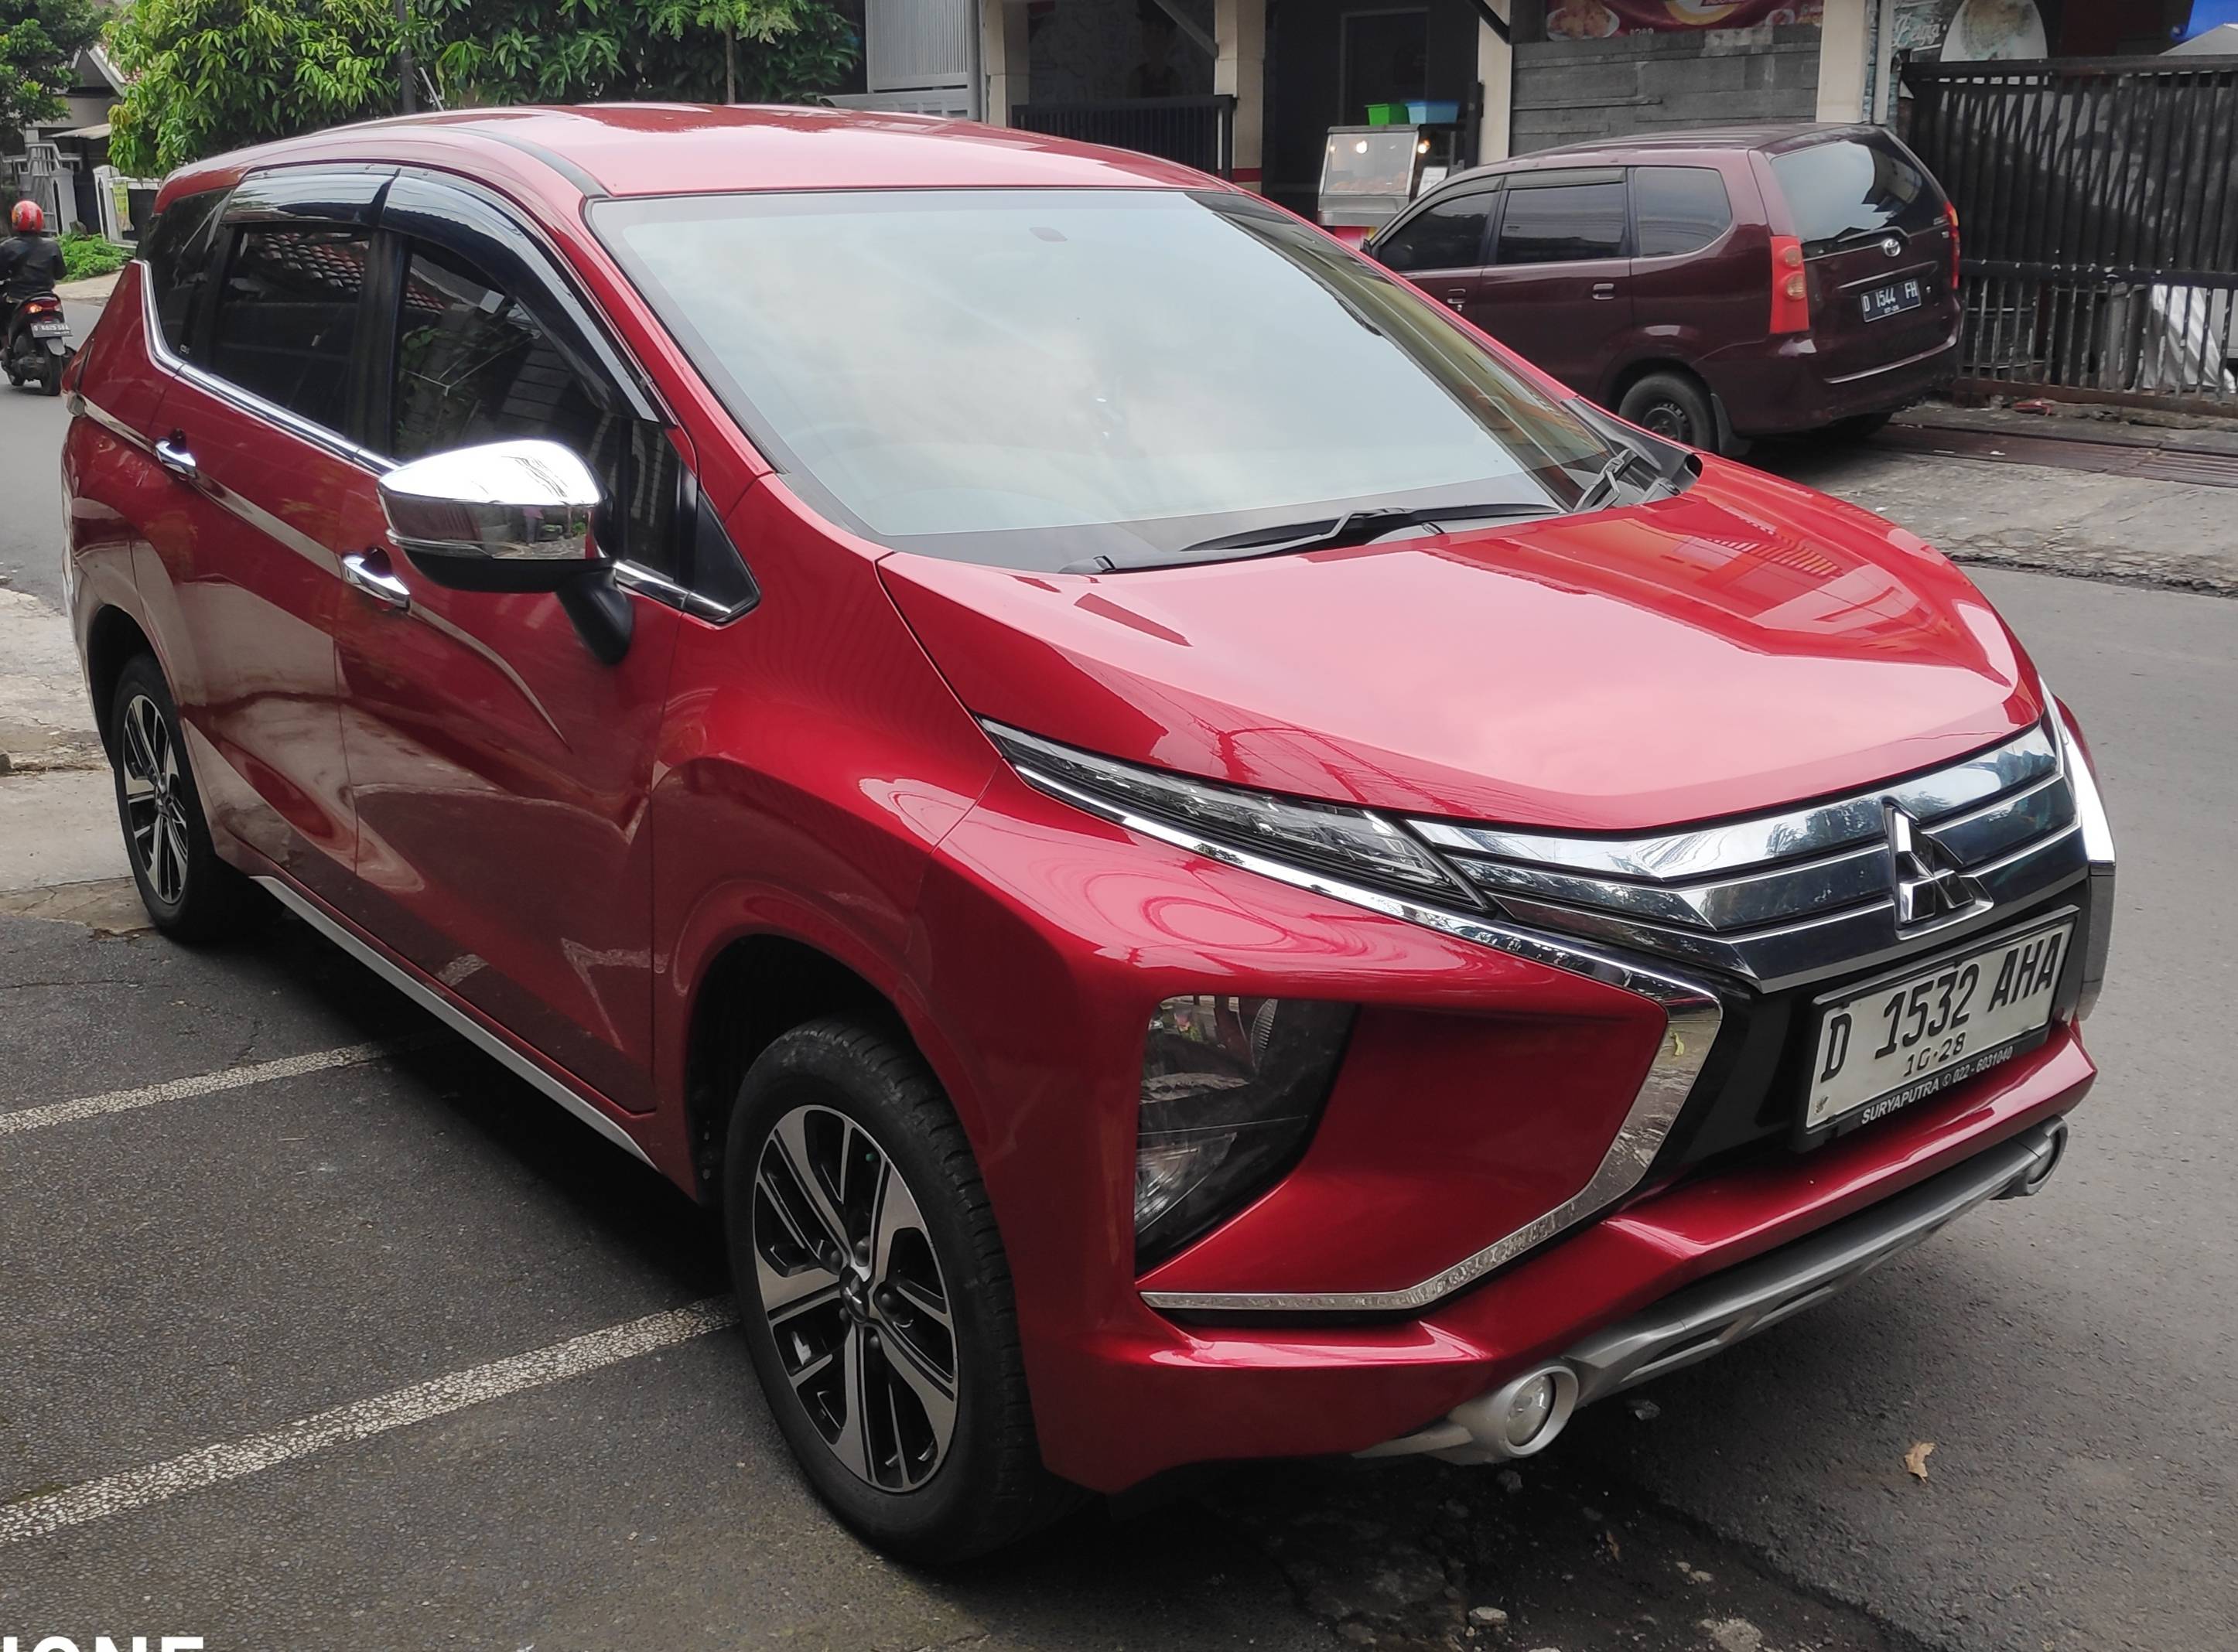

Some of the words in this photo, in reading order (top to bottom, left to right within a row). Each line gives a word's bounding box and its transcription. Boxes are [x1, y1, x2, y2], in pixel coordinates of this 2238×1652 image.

[1863, 295, 1871, 312] D
[1875, 287, 1896, 307] 1544
[1821, 1012, 1852, 1083] D
[1875, 964, 1980, 1059] 1532
[1987, 932, 2062, 1012] AHA
[1861, 1077, 1939, 1124] SURYAPUTRA
[1953, 1064, 1970, 1083] 022
